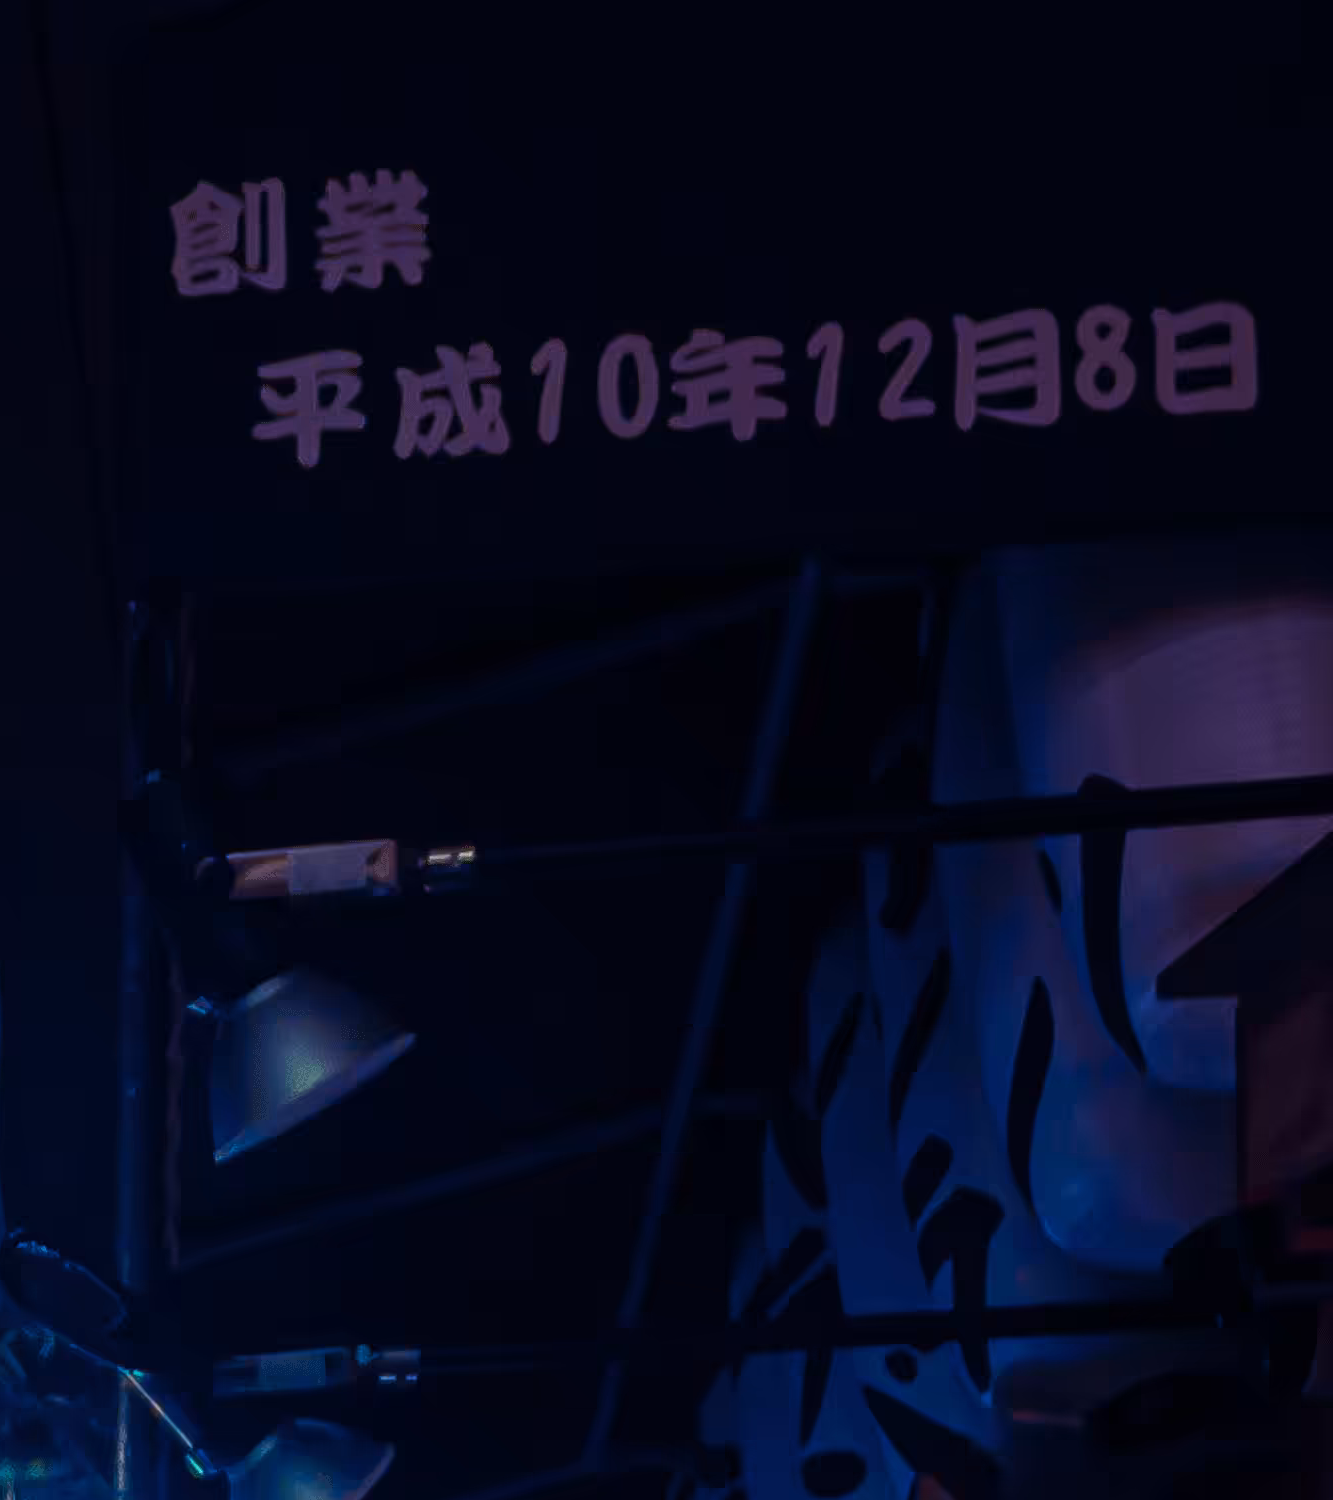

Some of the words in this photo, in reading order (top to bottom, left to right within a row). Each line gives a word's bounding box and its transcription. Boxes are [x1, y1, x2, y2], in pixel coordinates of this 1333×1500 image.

[168, 169, 433, 299] 創業
[250, 301, 1261, 468] 平成10年12月8日
